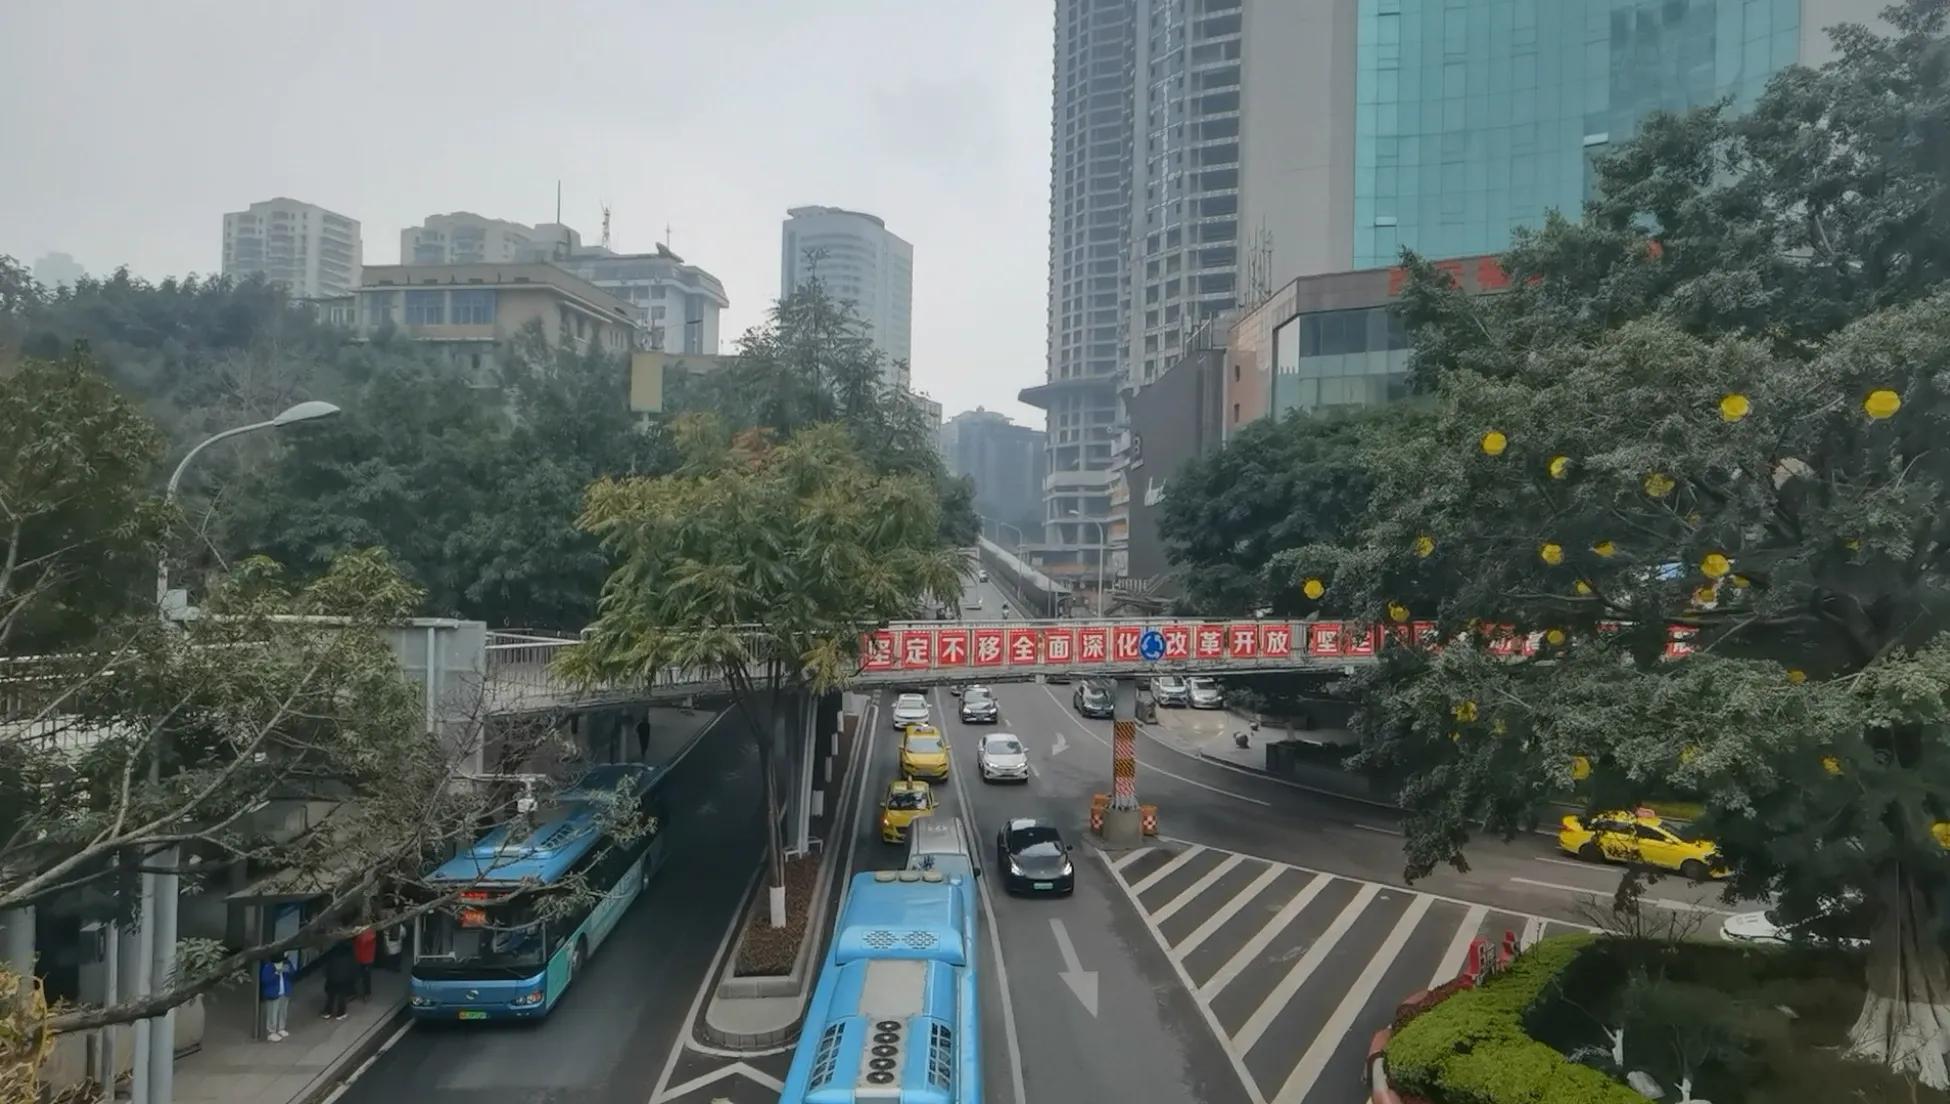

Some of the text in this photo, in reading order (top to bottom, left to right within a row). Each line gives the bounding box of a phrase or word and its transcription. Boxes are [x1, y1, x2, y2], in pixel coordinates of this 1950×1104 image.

[867, 631, 1288, 666] 坚定不移全面深化改革开放
